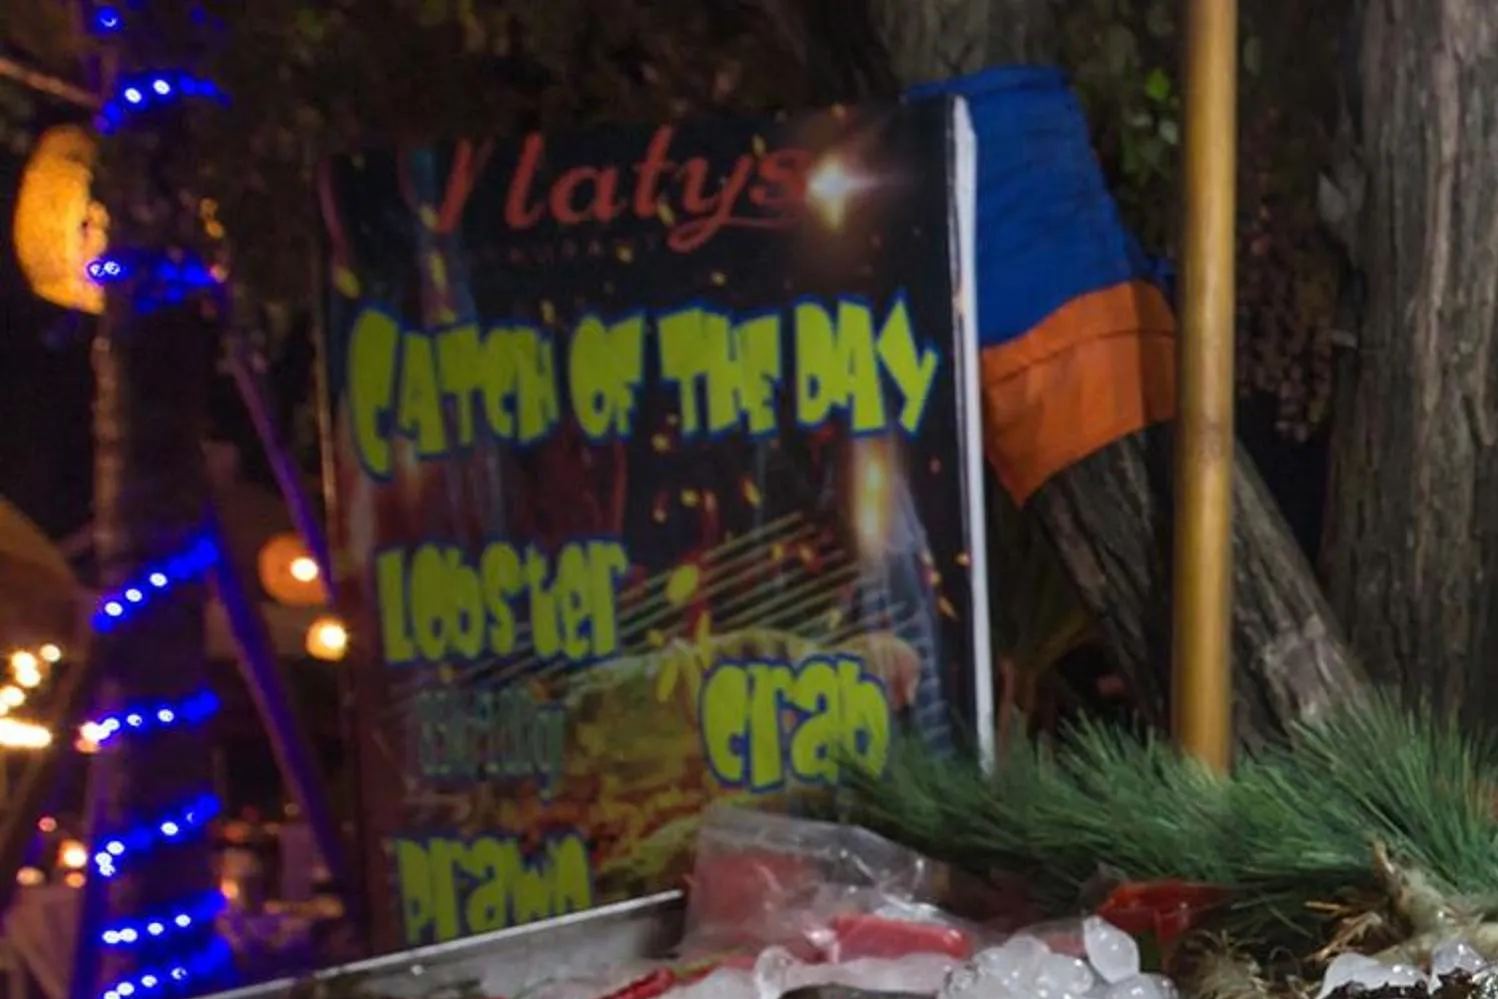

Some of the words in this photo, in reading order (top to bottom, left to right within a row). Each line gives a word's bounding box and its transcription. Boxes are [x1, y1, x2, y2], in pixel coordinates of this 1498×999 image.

[568, 310, 644, 440] OF
[656, 306, 781, 436] THE
[794, 294, 938, 435] DAY
